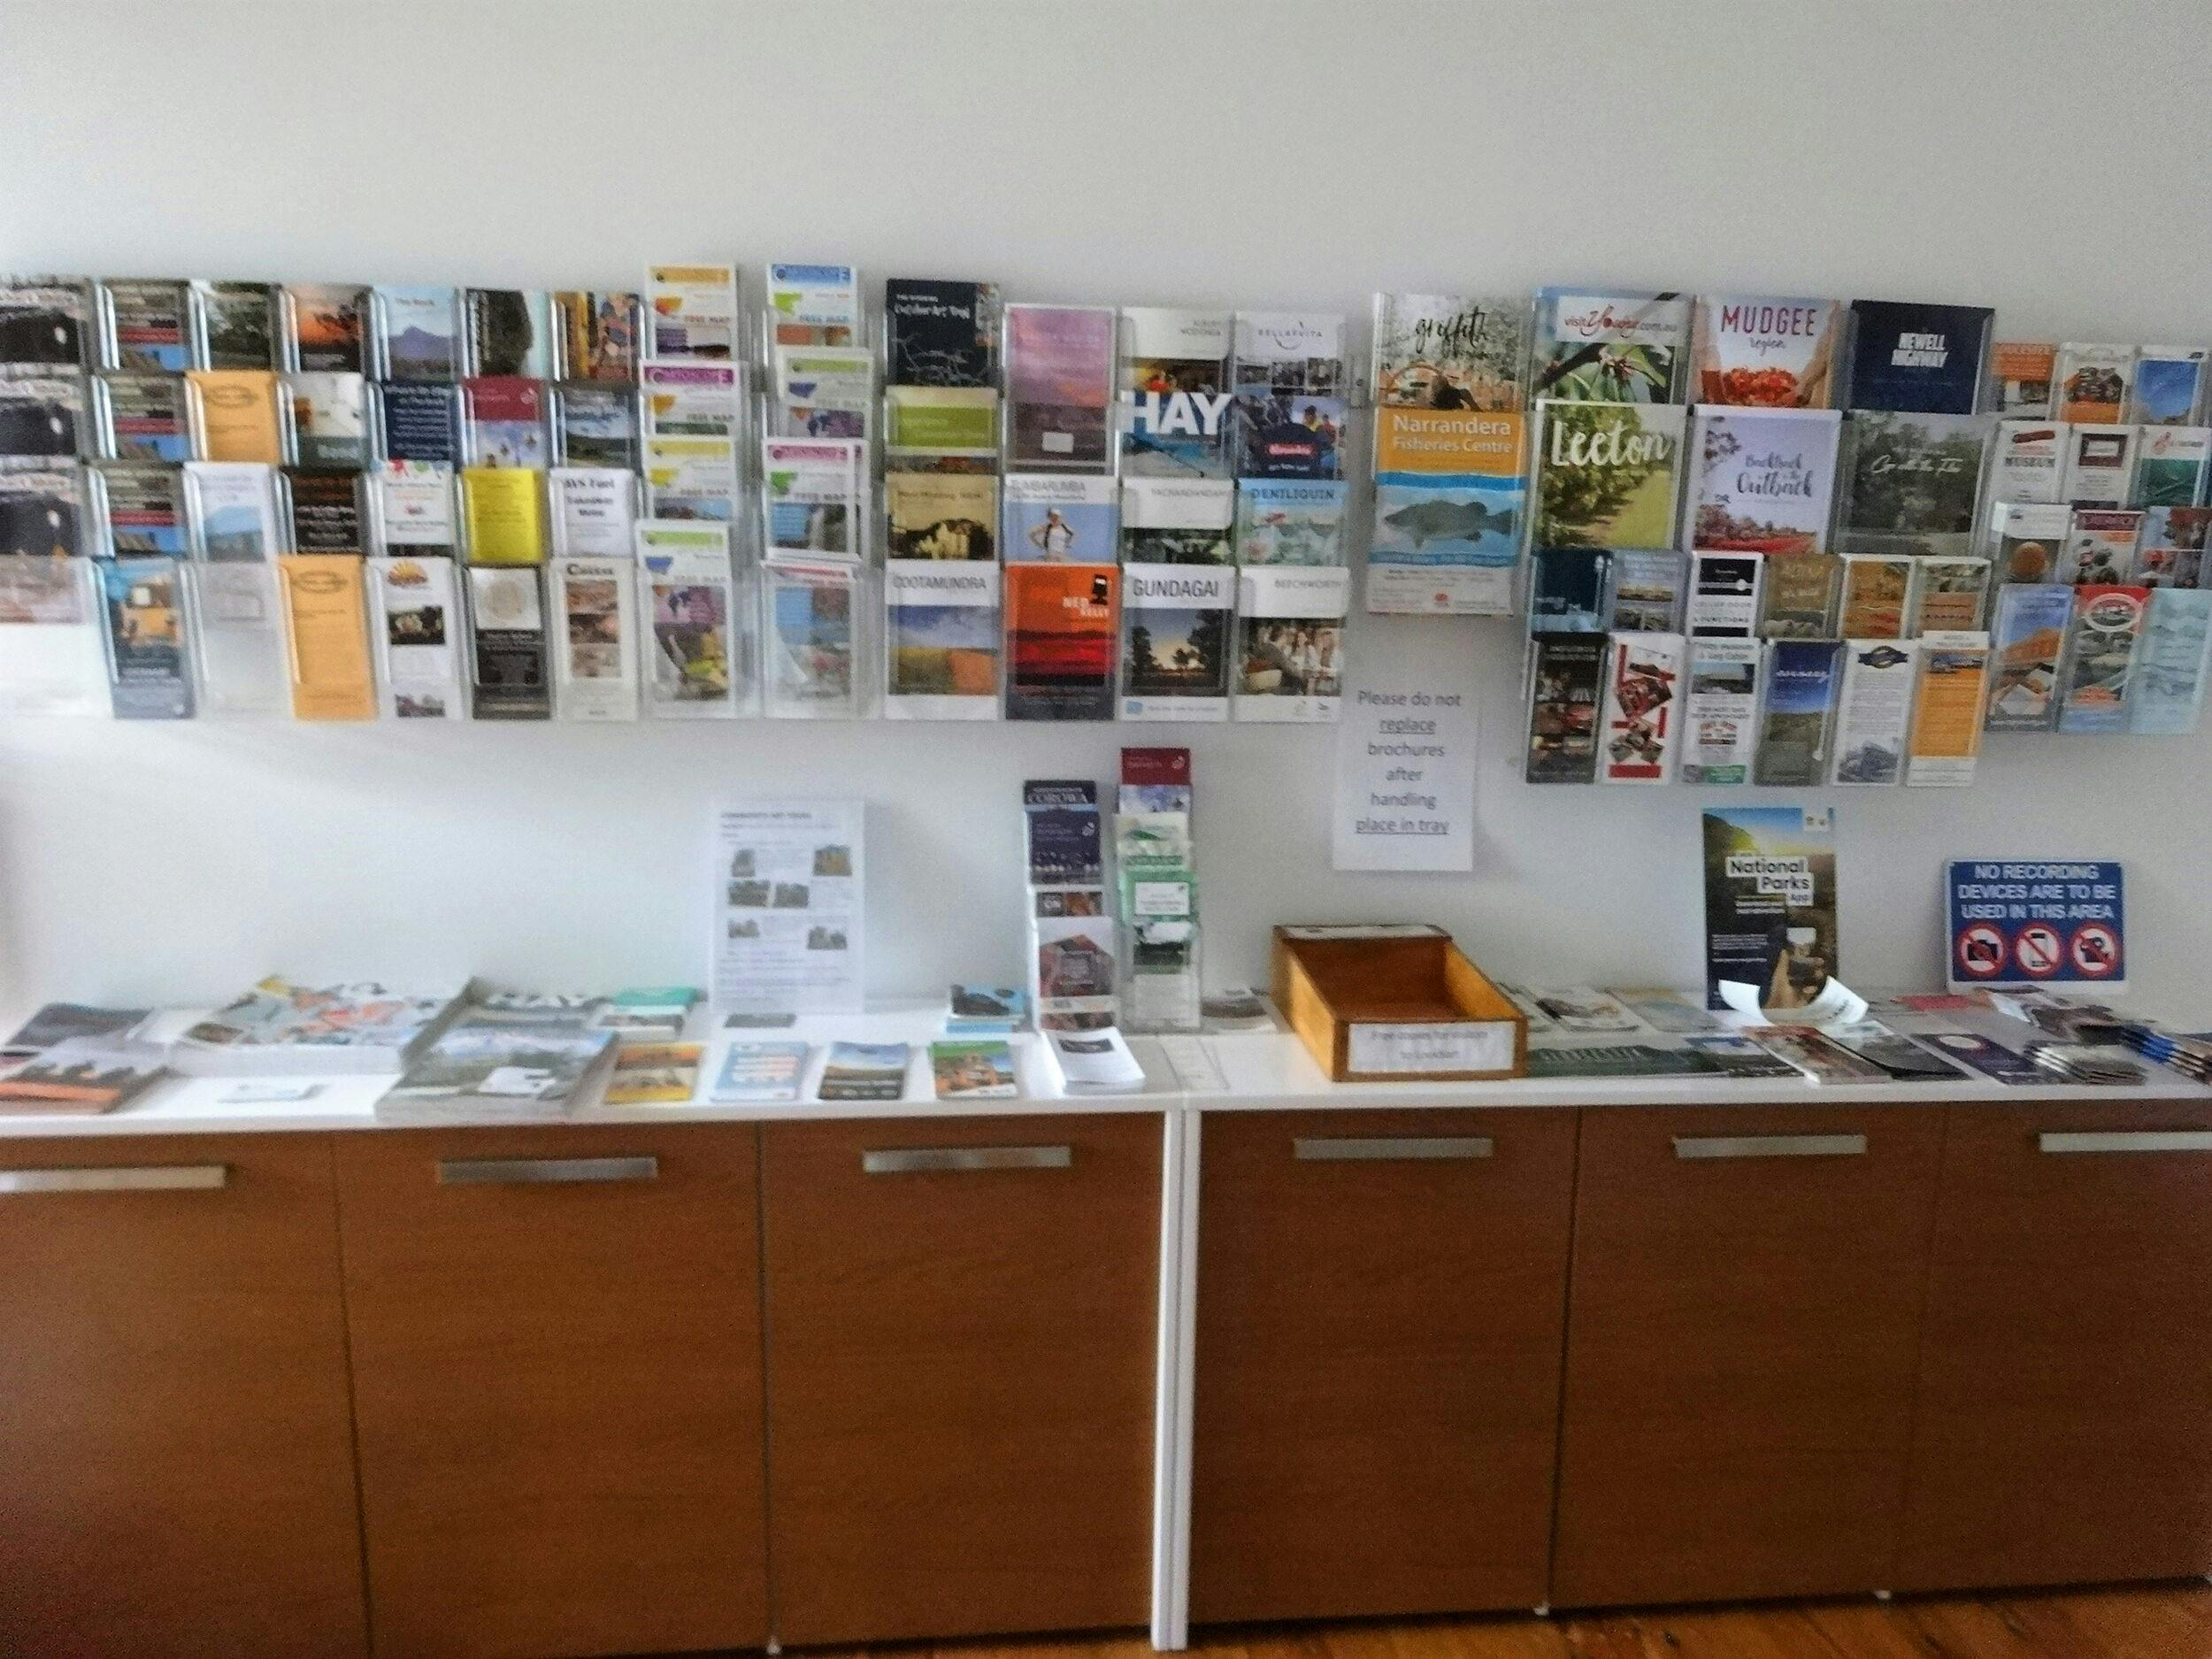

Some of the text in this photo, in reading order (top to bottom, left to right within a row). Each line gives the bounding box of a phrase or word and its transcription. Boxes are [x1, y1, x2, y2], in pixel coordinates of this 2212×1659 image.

[1721, 305, 1816, 336] MUDGEE
[1121, 390, 1233, 434] HAY
[1393, 415, 1511, 435] Narrandera
[1393, 436, 1513, 453] Fisheries Centre
[1552, 420, 1671, 467] Leeton
[1133, 579, 1219, 598] GUNDAGAI
[1358, 690, 1462, 707] Please do not
[1379, 718, 1437, 733] replace
[1368, 741, 1445, 757] brochures
[1386, 766, 1424, 781] after
[1371, 792, 1438, 810] handling
[1356, 818, 1449, 834] place in tray
[1729, 859, 1805, 874] National
[1974, 864, 2100, 879] NO RECORDING
[1761, 876, 1810, 891] Parks
[1957, 884, 2116, 899] DEVICES ARE TO BE
[1961, 904, 2115, 919] USED IN THIS AREA
